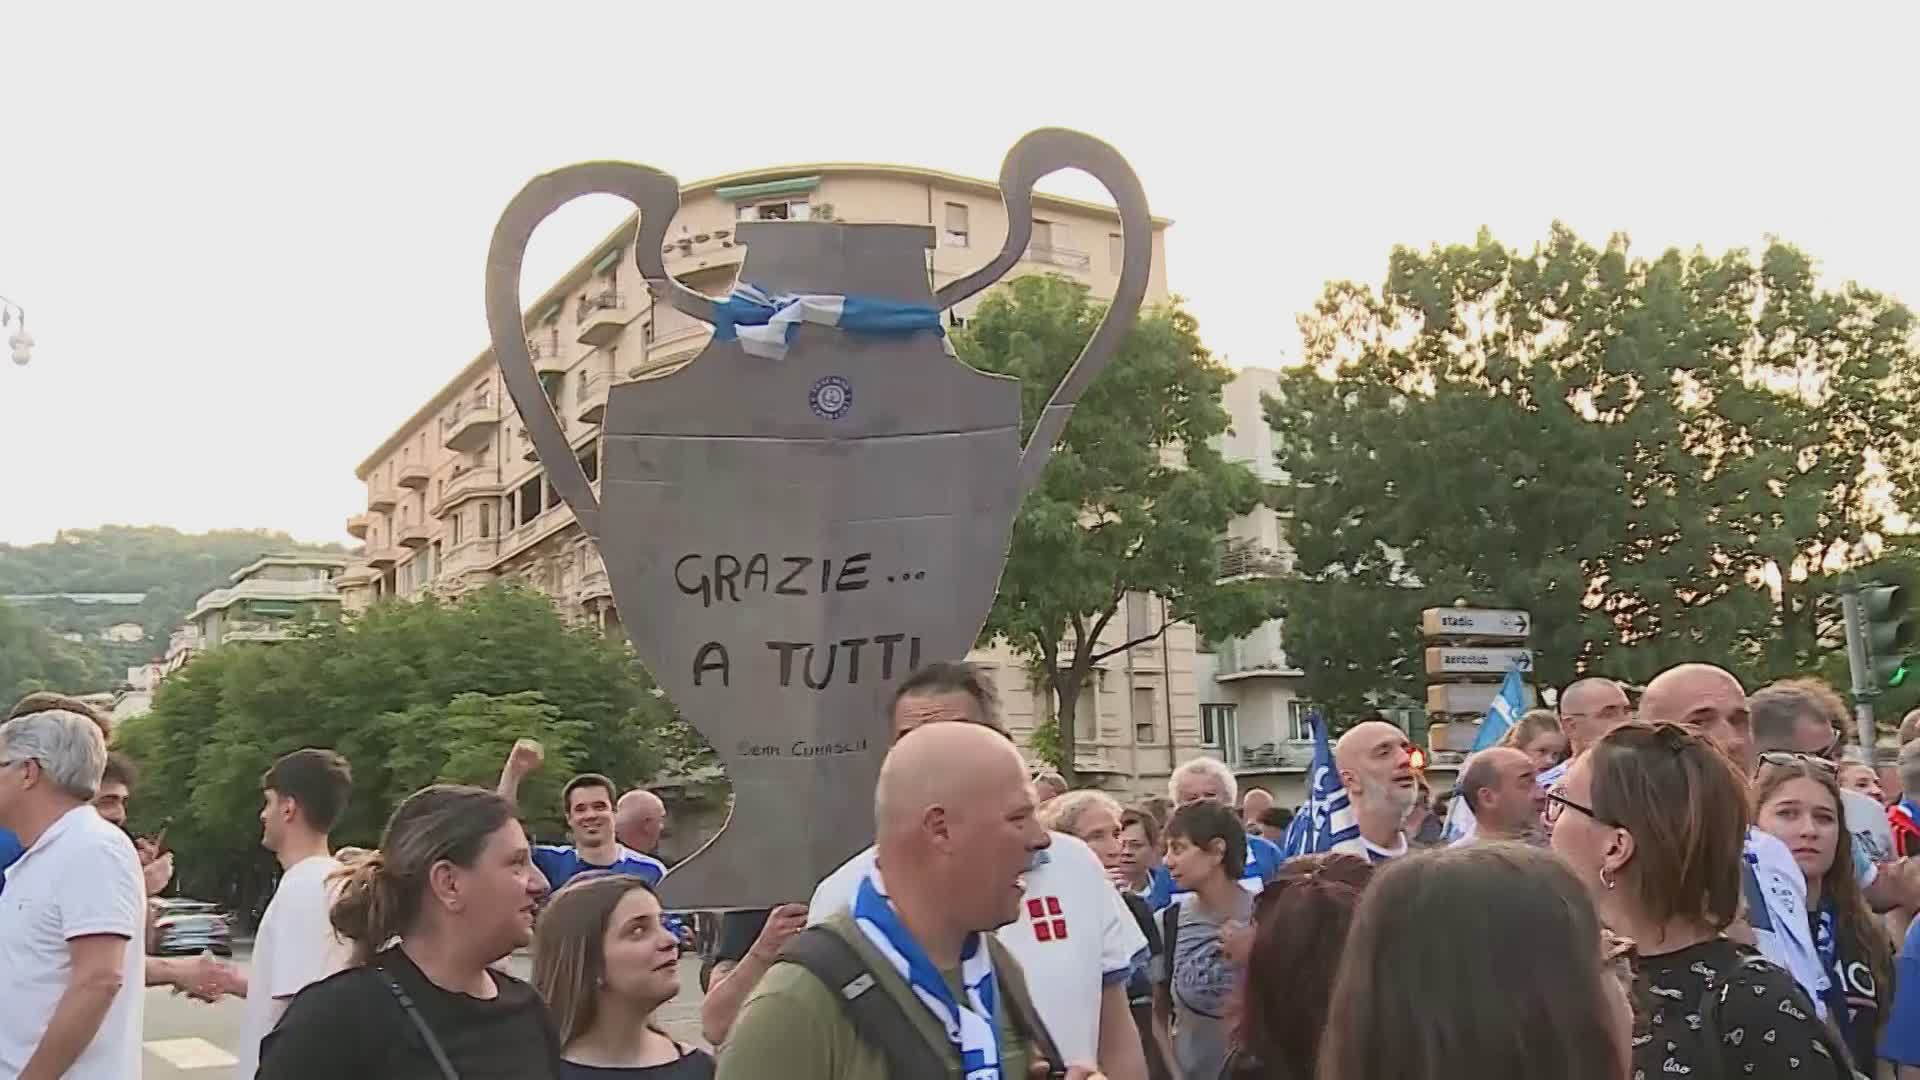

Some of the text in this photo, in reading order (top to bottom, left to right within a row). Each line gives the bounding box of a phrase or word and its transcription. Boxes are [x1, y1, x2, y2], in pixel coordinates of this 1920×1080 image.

[1442, 615, 1474, 626] stadio
[693, 632, 921, 690] A TUTTI
